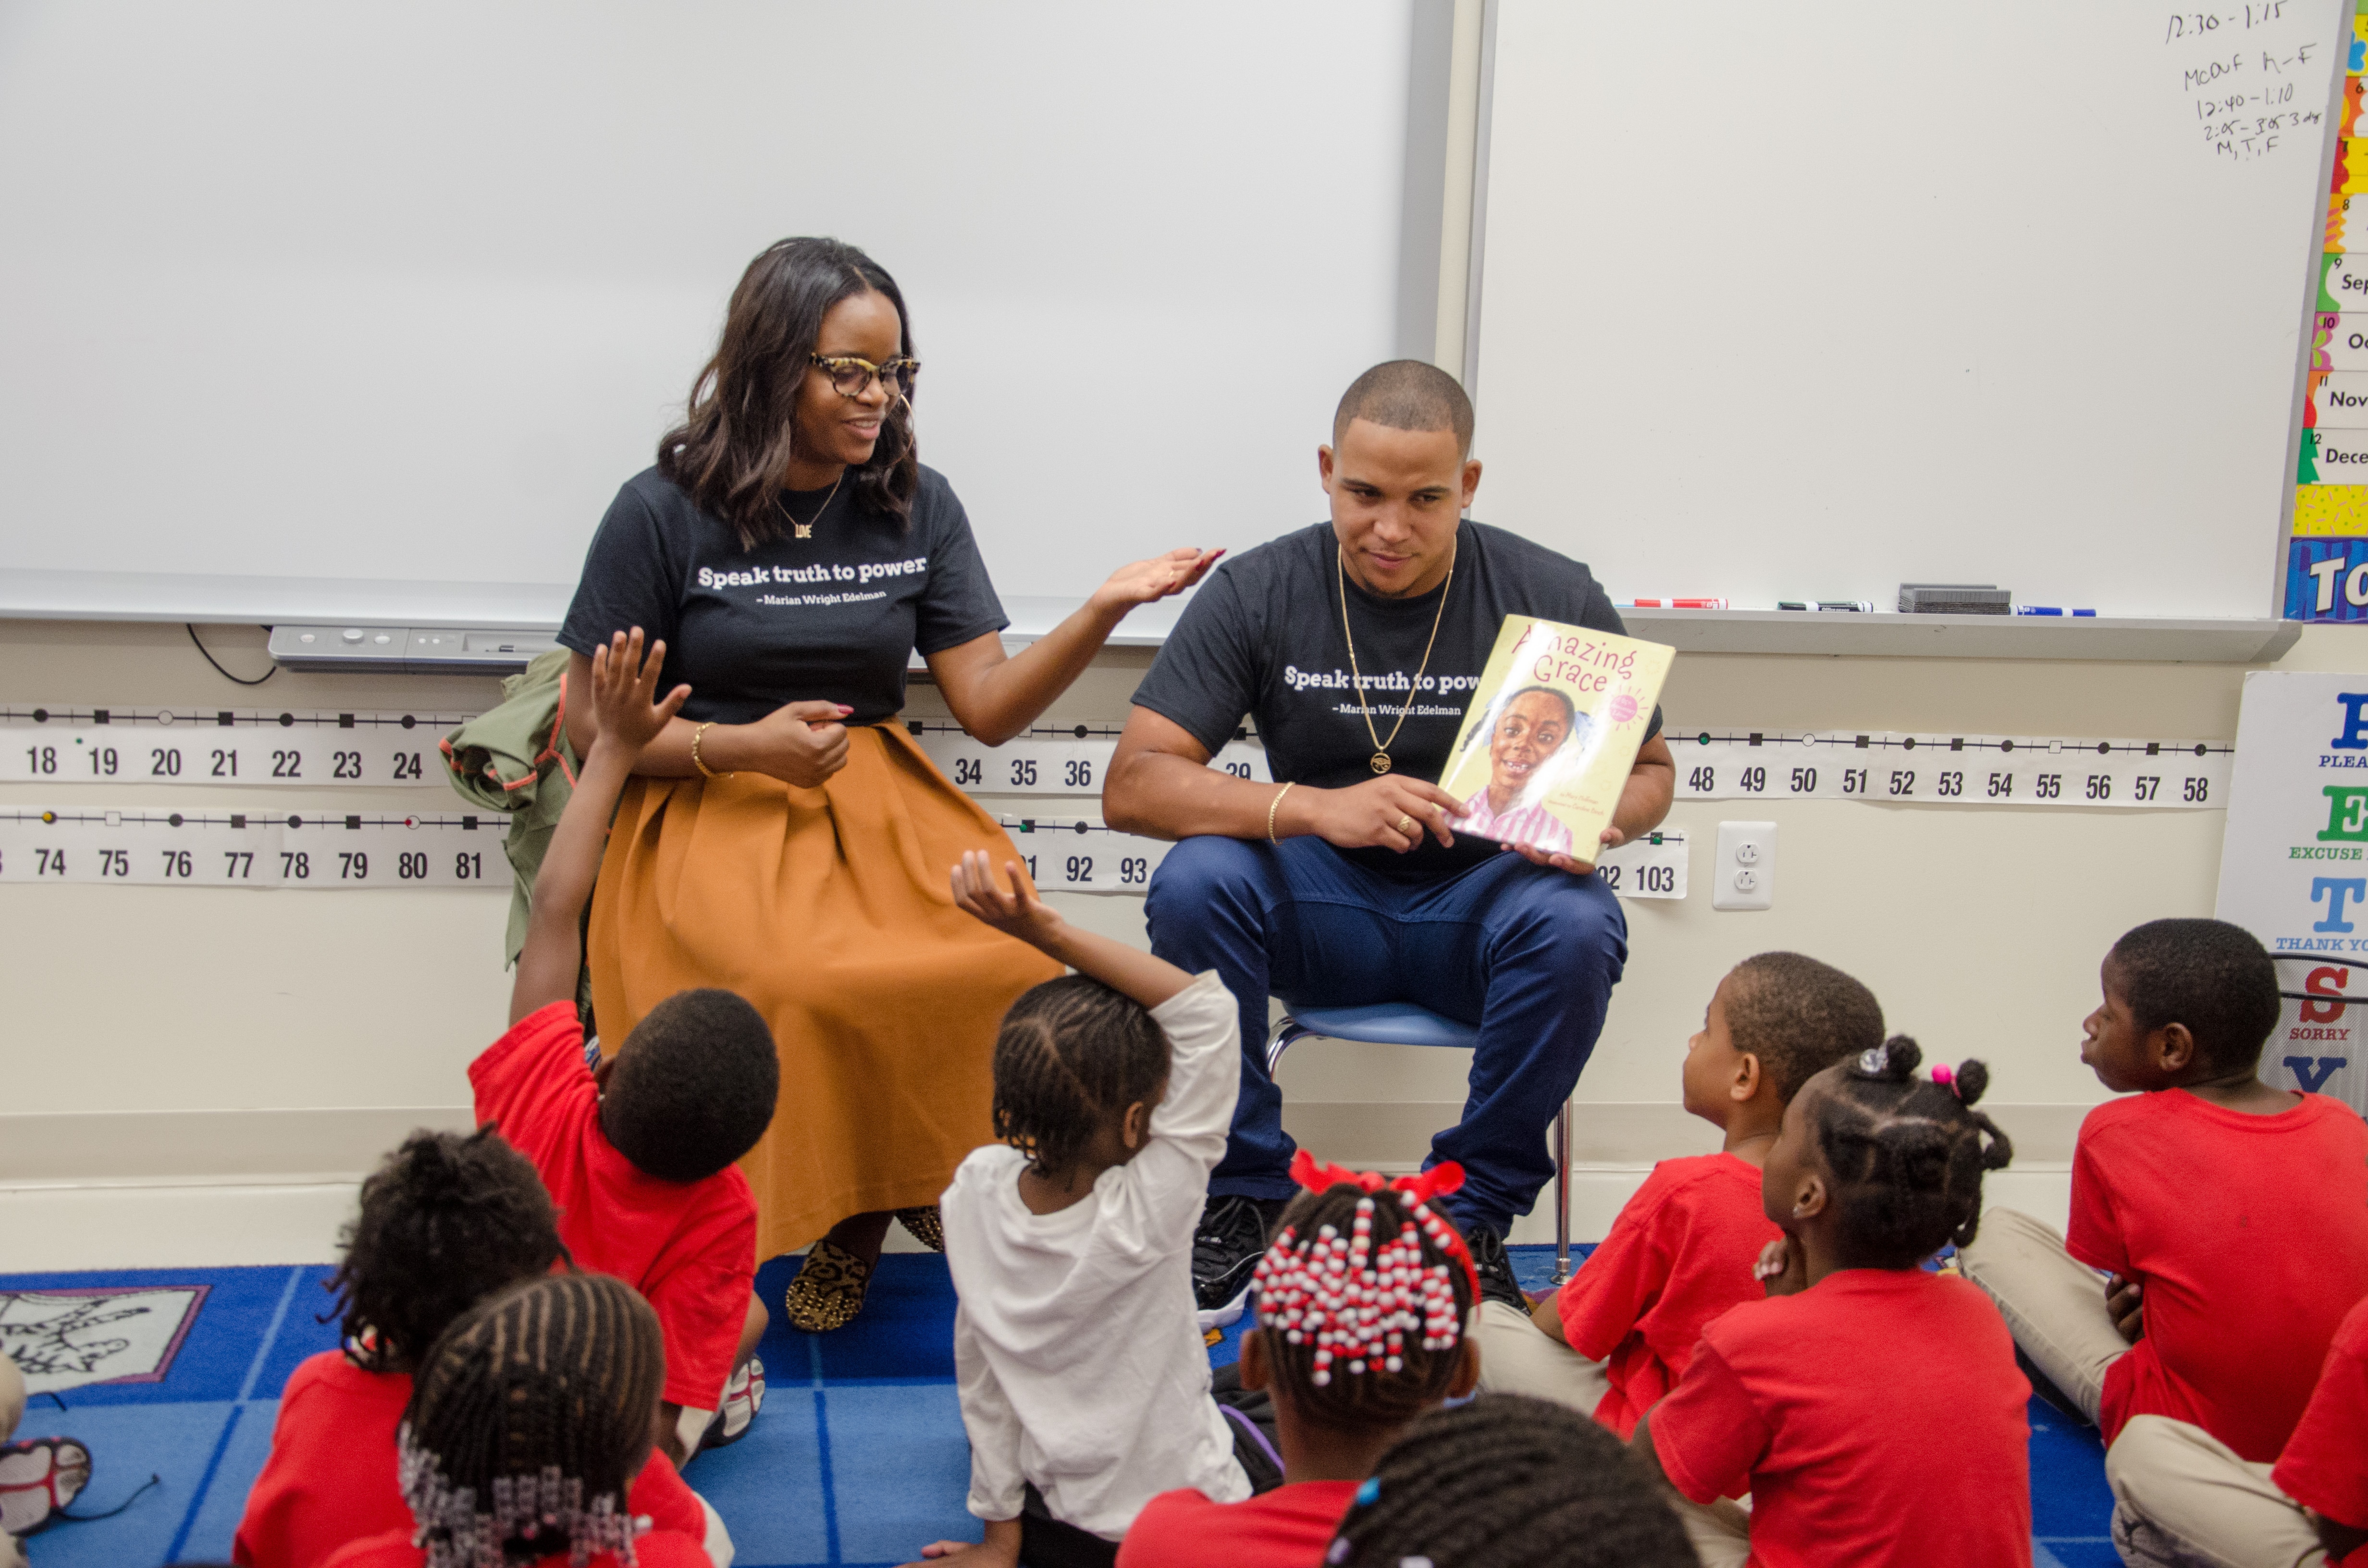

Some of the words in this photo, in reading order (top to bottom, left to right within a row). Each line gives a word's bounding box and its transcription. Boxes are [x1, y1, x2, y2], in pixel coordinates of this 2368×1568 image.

[2356, 83, 2363, 94] 6
[2339, 140, 2349, 152] 7
[2342, 199, 2350, 211] 8
[2334, 257, 2343, 269] 9
[2323, 317, 2335, 329] 10
[2319, 376, 2329, 387] 11
[2309, 433, 2322, 445] 12
[2325, 448, 2368, 464] Dece
[698, 566, 770, 591] Speak
[772, 564, 831, 583] truth
[832, 564, 855, 581] to
[858, 557, 927, 584] power
[802, 594, 842, 606] Wright
[841, 591, 887, 602] Edelman
[1284, 665, 1349, 691] Speak
[1353, 671, 1410, 690] truth
[1413, 673, 1435, 690] to
[1438, 675, 1481, 695] pow
[1534, 654, 1607, 692] Grace
[1378, 704, 1416, 716] Wright
[1417, 705, 1462, 716] Edelman
[2319, 755, 2368, 769] PLEA
[27, 747, 57, 774] 18
[89, 747, 118, 775] 19
[151, 748, 181, 776] 20
[211, 749, 237, 776] 21
[272, 750, 301, 777] 22
[333, 751, 362, 779] 23
[393, 752, 422, 779] 24
[955, 758, 982, 785] 34
[1011, 759, 1037, 786] 35
[1065, 760, 1091, 787] 36
[1689, 766, 1714, 792] 48
[1740, 767, 1766, 792] 49
[1790, 768, 1817, 793] 50
[1843, 769, 1867, 793] 51
[1889, 771, 1915, 795] 52
[1938, 772, 1963, 796] 53
[1987, 772, 2013, 797] 54
[2036, 774, 2062, 798] 55
[2086, 774, 2111, 799] 56
[2134, 776, 2160, 800] 57
[2183, 777, 2208, 802] 58
[2317, 785, 2368, 843] E
[2288, 846, 2363, 860] EXCUSE
[35, 848, 66, 875] 74
[99, 850, 129, 877] 75
[162, 850, 192, 878] 76
[224, 852, 254, 878] 77
[280, 852, 309, 879] 78
[339, 852, 368, 879] 79
[399, 852, 428, 879] 80
[456, 852, 481, 879] 81
[1066, 856, 1093, 882] 92
[1121, 858, 1147, 884] 93
[1636, 866, 1674, 892] 103
[2310, 877, 2367, 933] T
[2276, 937, 2344, 951] THANK
[2348, 939, 2368, 952] YO
[2299, 966, 2349, 1024] S
[2289, 1027, 2351, 1041] SORRY
